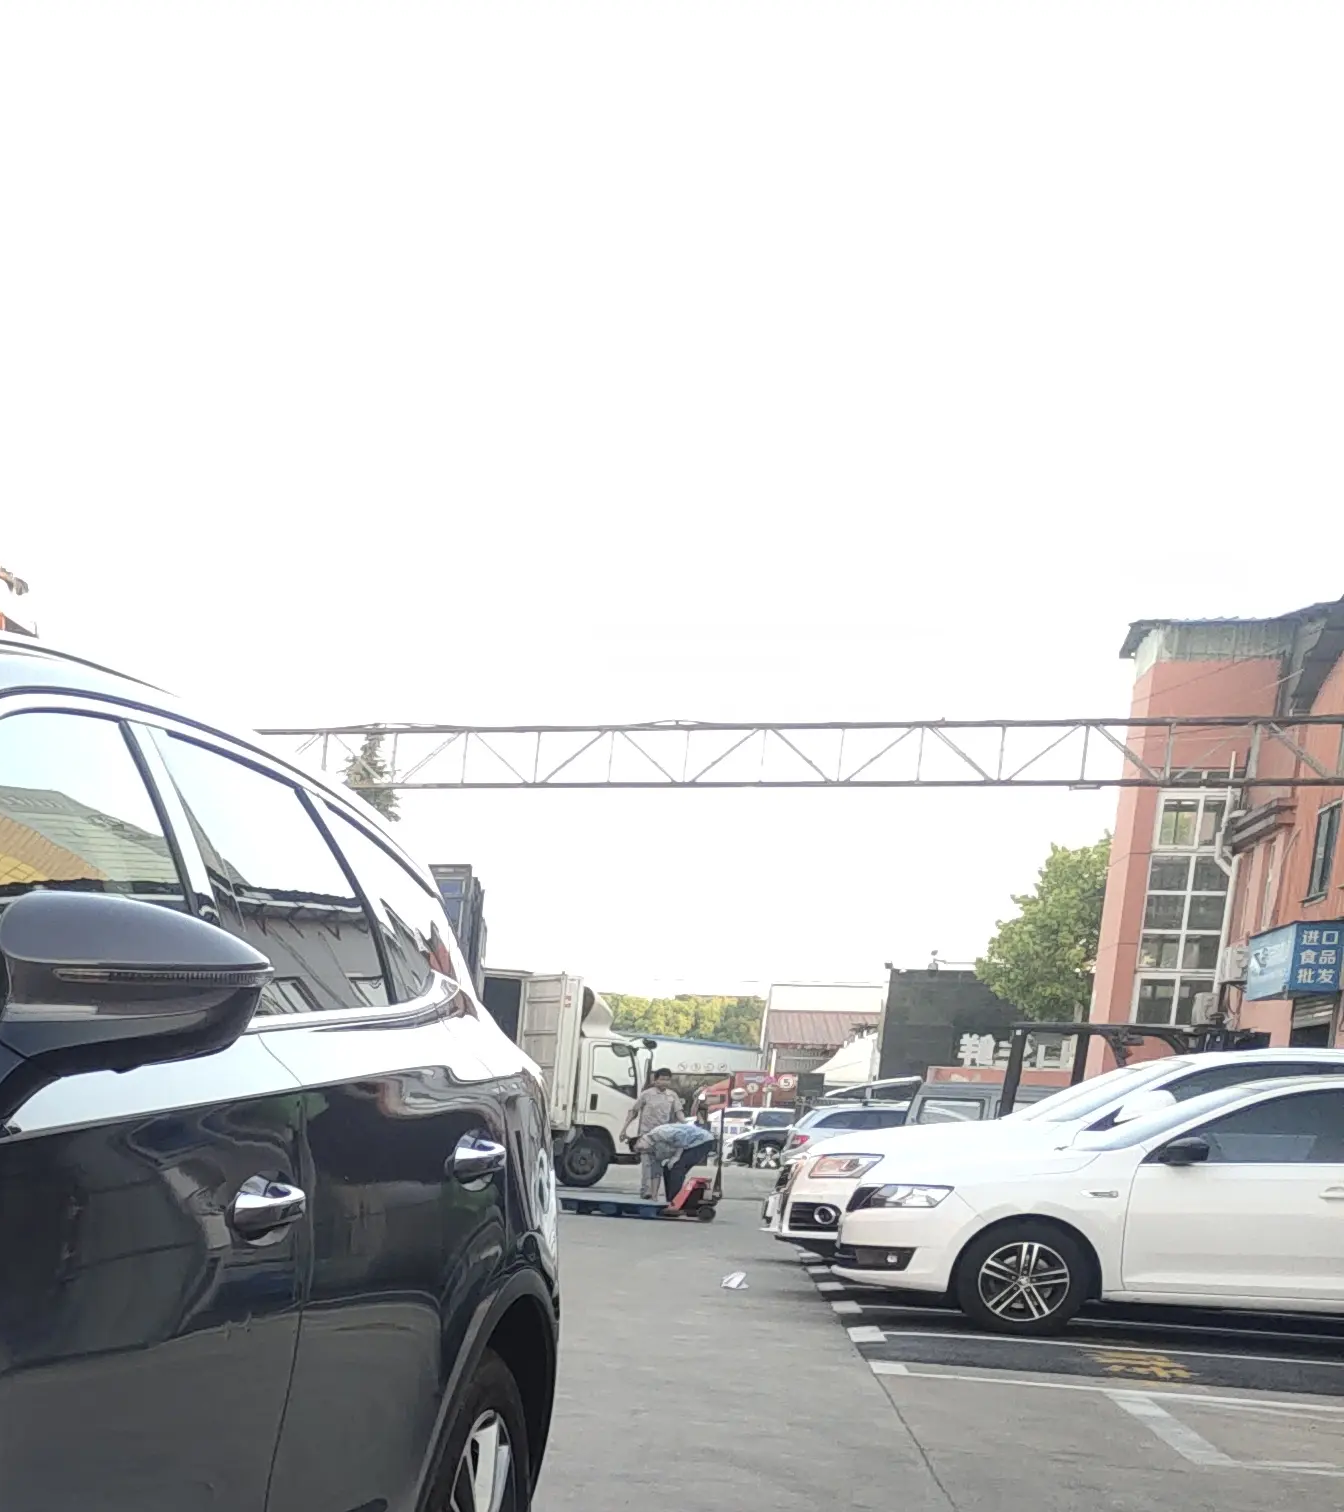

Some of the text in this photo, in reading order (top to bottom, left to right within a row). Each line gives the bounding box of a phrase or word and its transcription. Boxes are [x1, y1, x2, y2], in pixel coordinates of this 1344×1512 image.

[1301, 929, 1339, 945] 进口
[1300, 949, 1336, 965] 食品
[1296, 968, 1335, 984] 批发
